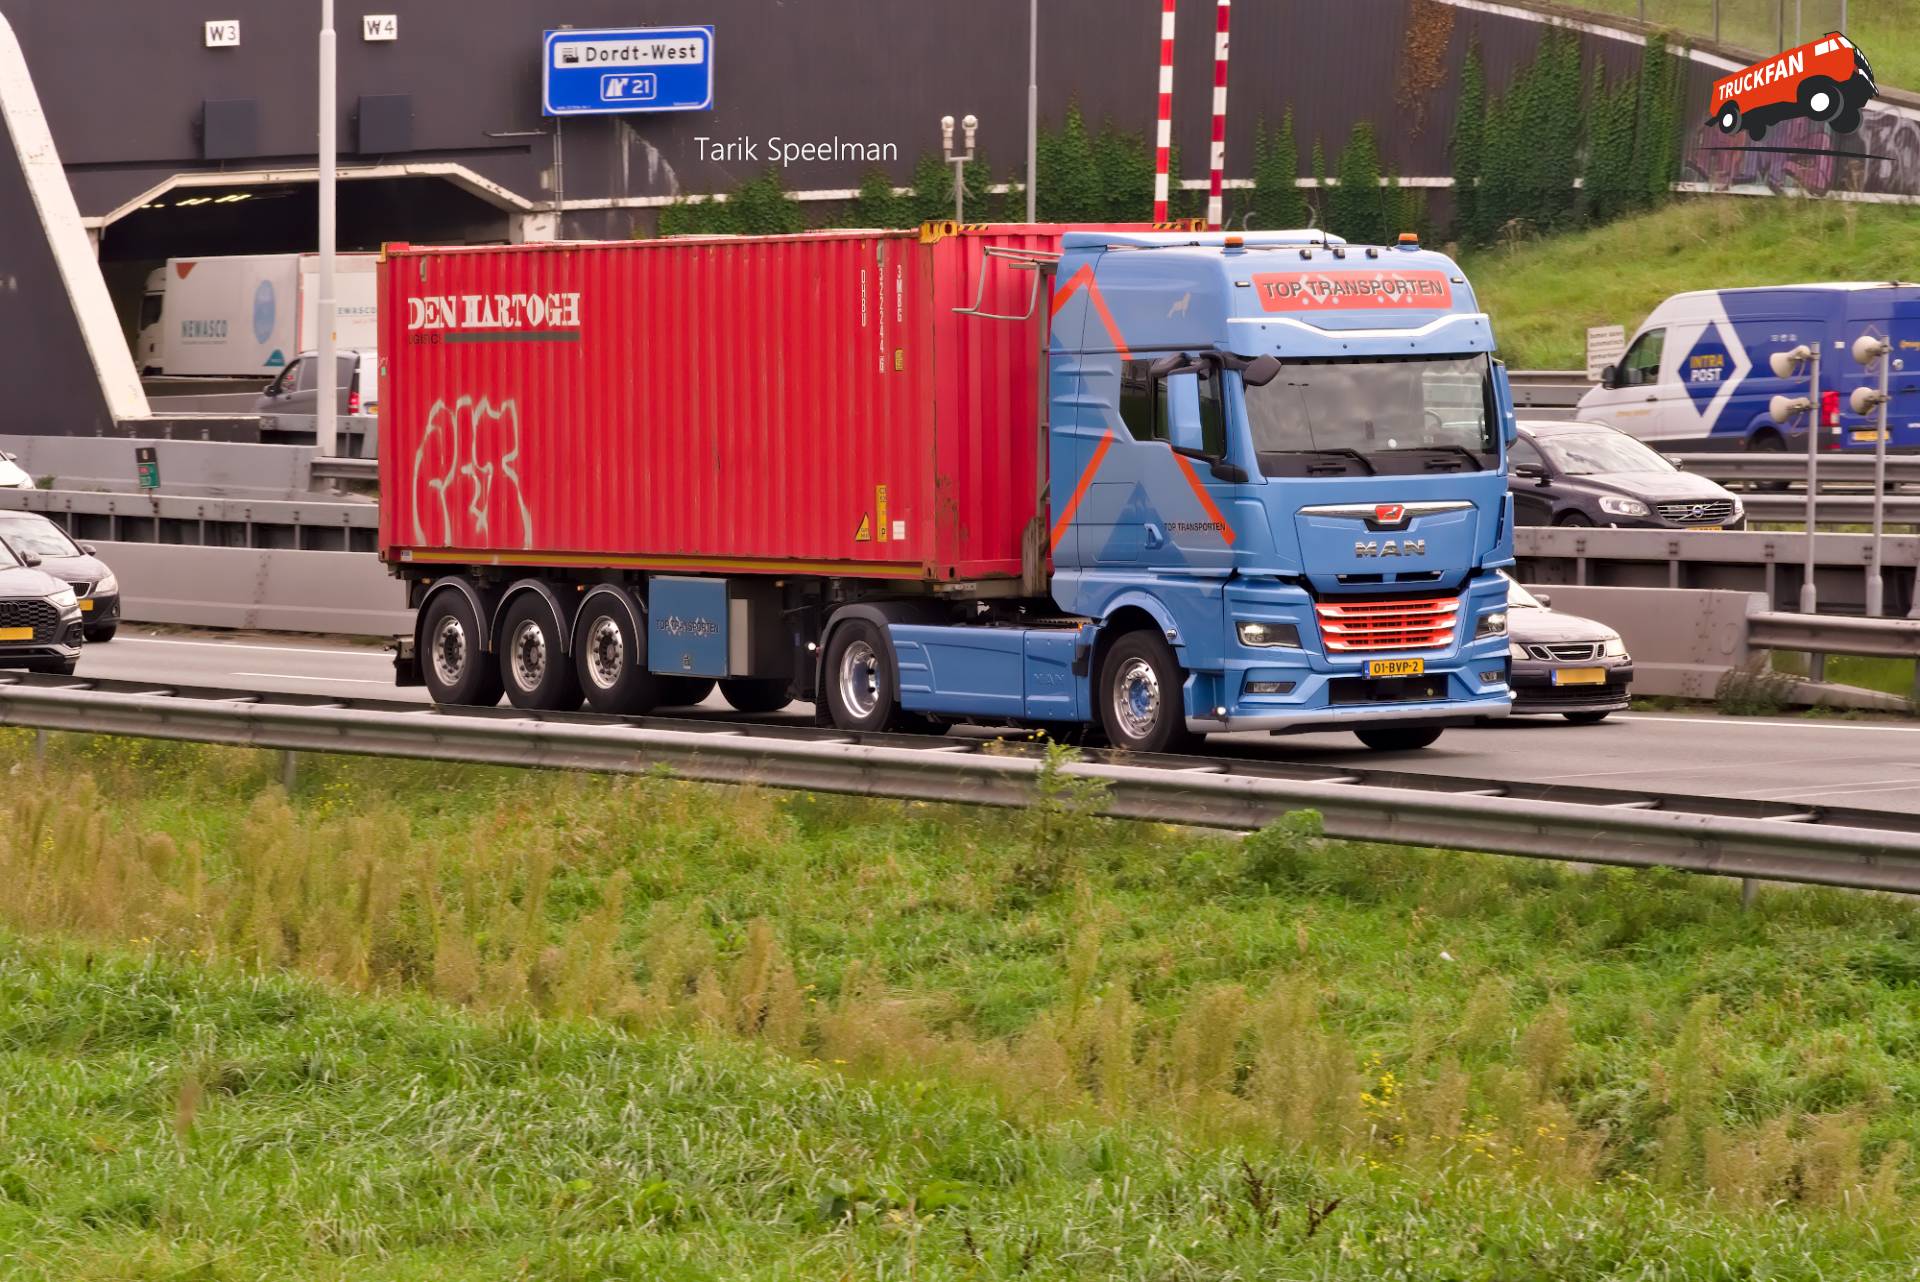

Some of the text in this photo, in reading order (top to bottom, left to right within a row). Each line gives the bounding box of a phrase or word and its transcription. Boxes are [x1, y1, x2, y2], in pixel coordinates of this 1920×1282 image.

[209, 26, 237, 42] W3
[366, 20, 395, 36] W4
[585, 44, 697, 62] Dordt-West
[631, 79, 650, 94] 21
[1264, 279, 1445, 299] TOP TRANSPORTEN
[337, 306, 377, 315] EWASCO
[408, 292, 581, 330] DEN HARTOGH
[181, 320, 229, 338] NEWASCO
[1690, 354, 1725, 369] INTRA
[1690, 368, 1722, 382] POST
[1164, 522, 1226, 531] TOP TRANSPORTEN
[1354, 539, 1426, 558] MAN
[1373, 661, 1419, 674] 01-BVP-2
